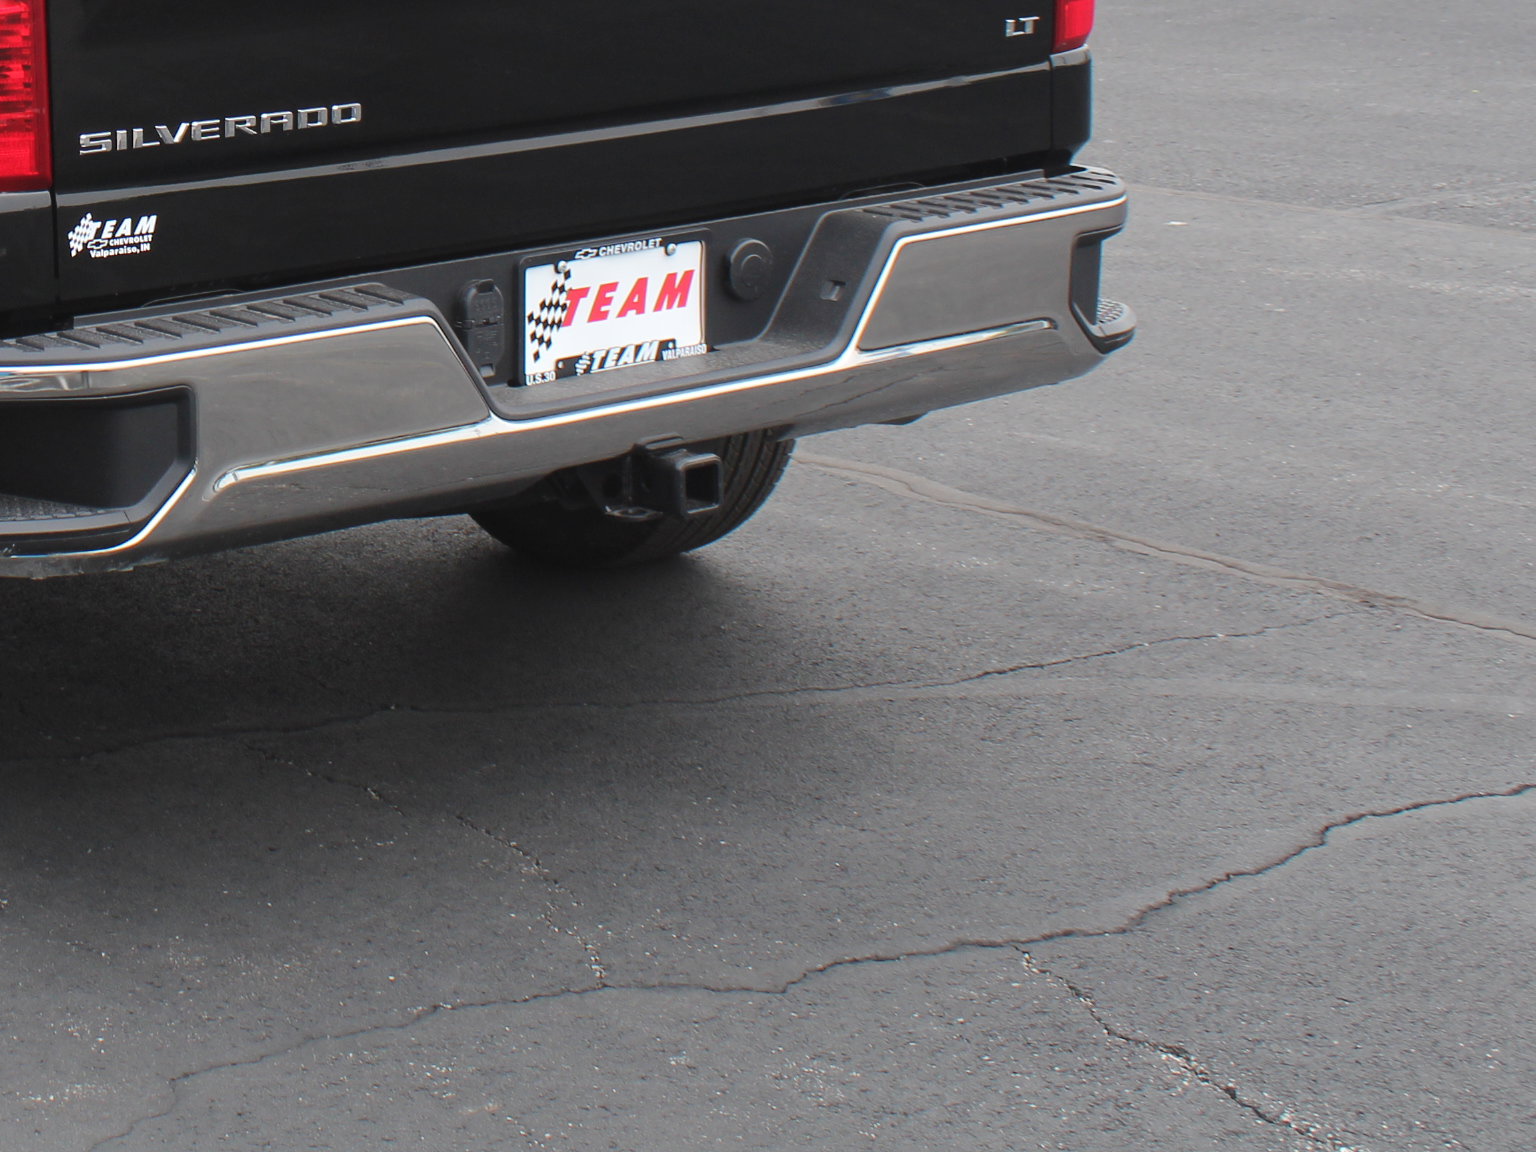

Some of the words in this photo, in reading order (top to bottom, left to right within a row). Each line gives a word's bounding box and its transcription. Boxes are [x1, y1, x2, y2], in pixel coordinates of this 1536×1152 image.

[1005, 16, 1041, 37] LT
[79, 102, 363, 156] SILVERADO
[88, 215, 157, 241] TEAM
[109, 234, 153, 246] CHEVROLET
[598, 238, 662, 257] CHEVROLET
[561, 269, 695, 327] TEAM
[590, 340, 661, 372] TEAM
[662, 344, 707, 361] VALPARAISO
